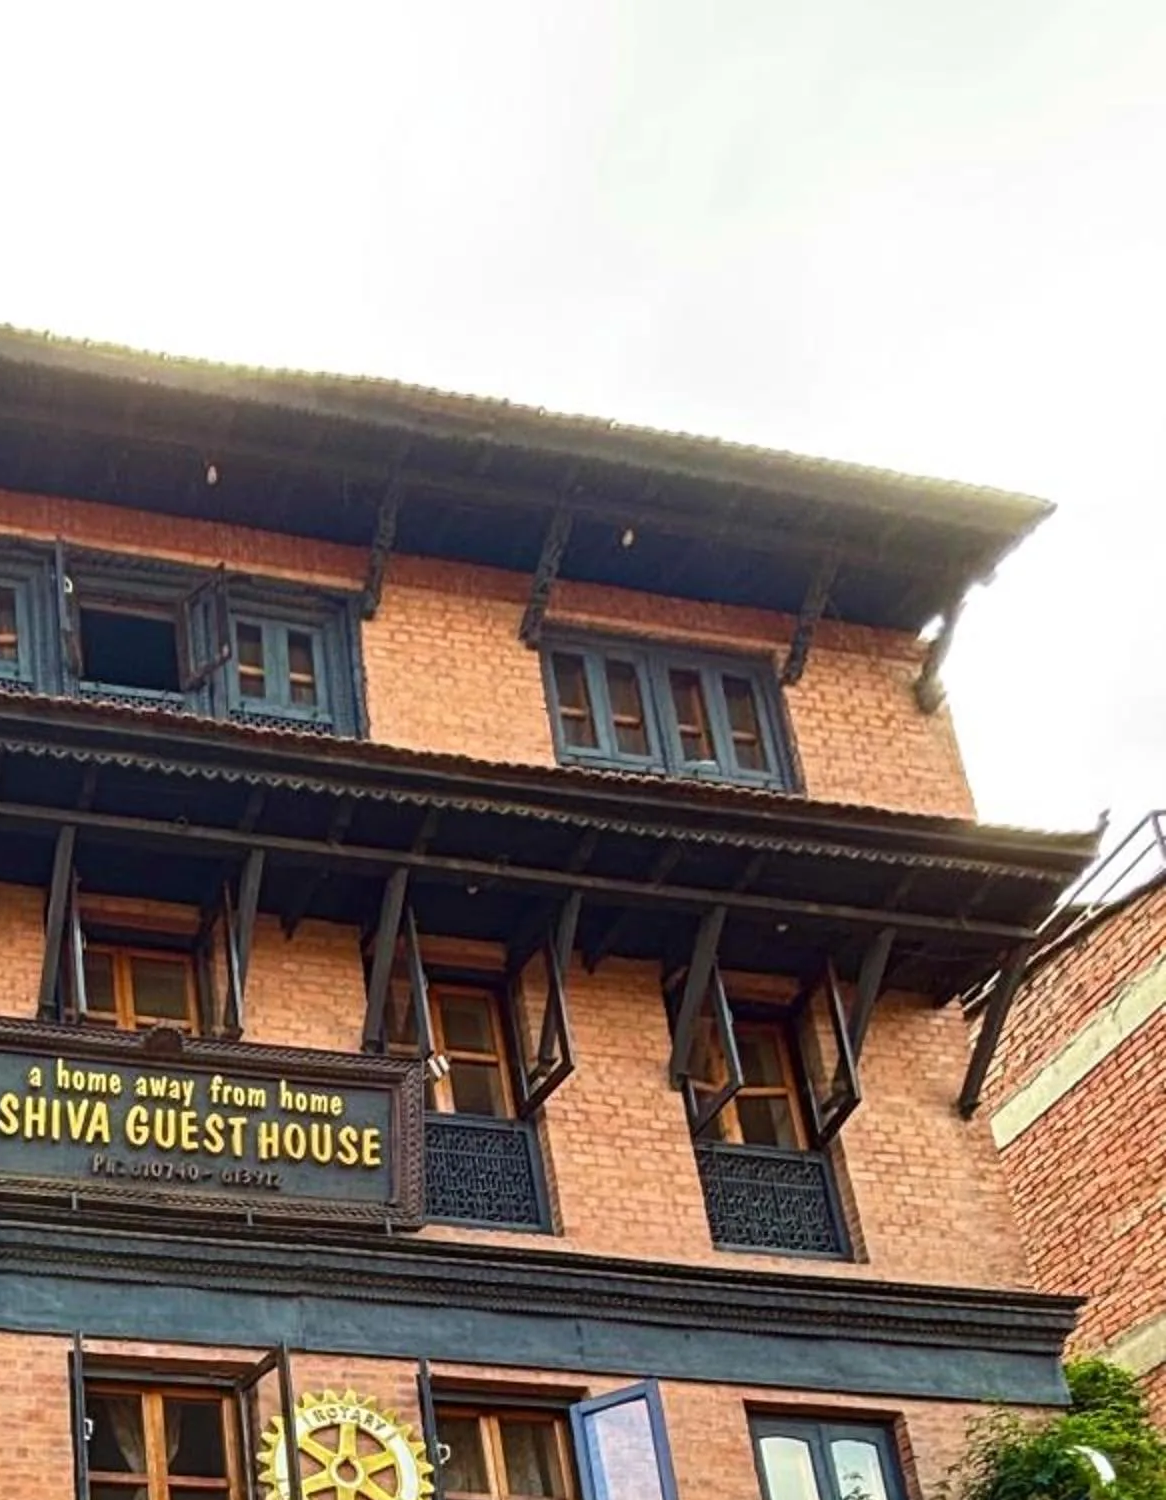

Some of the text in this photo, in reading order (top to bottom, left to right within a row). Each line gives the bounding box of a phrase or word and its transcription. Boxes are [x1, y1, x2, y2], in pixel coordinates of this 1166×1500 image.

[28, 1058, 343, 1116] a home away from home
[124, 1105, 249, 1159] GUEST
[256, 1121, 383, 1167] HOUSE
[312, 1406, 387, 1432] ROTARY
